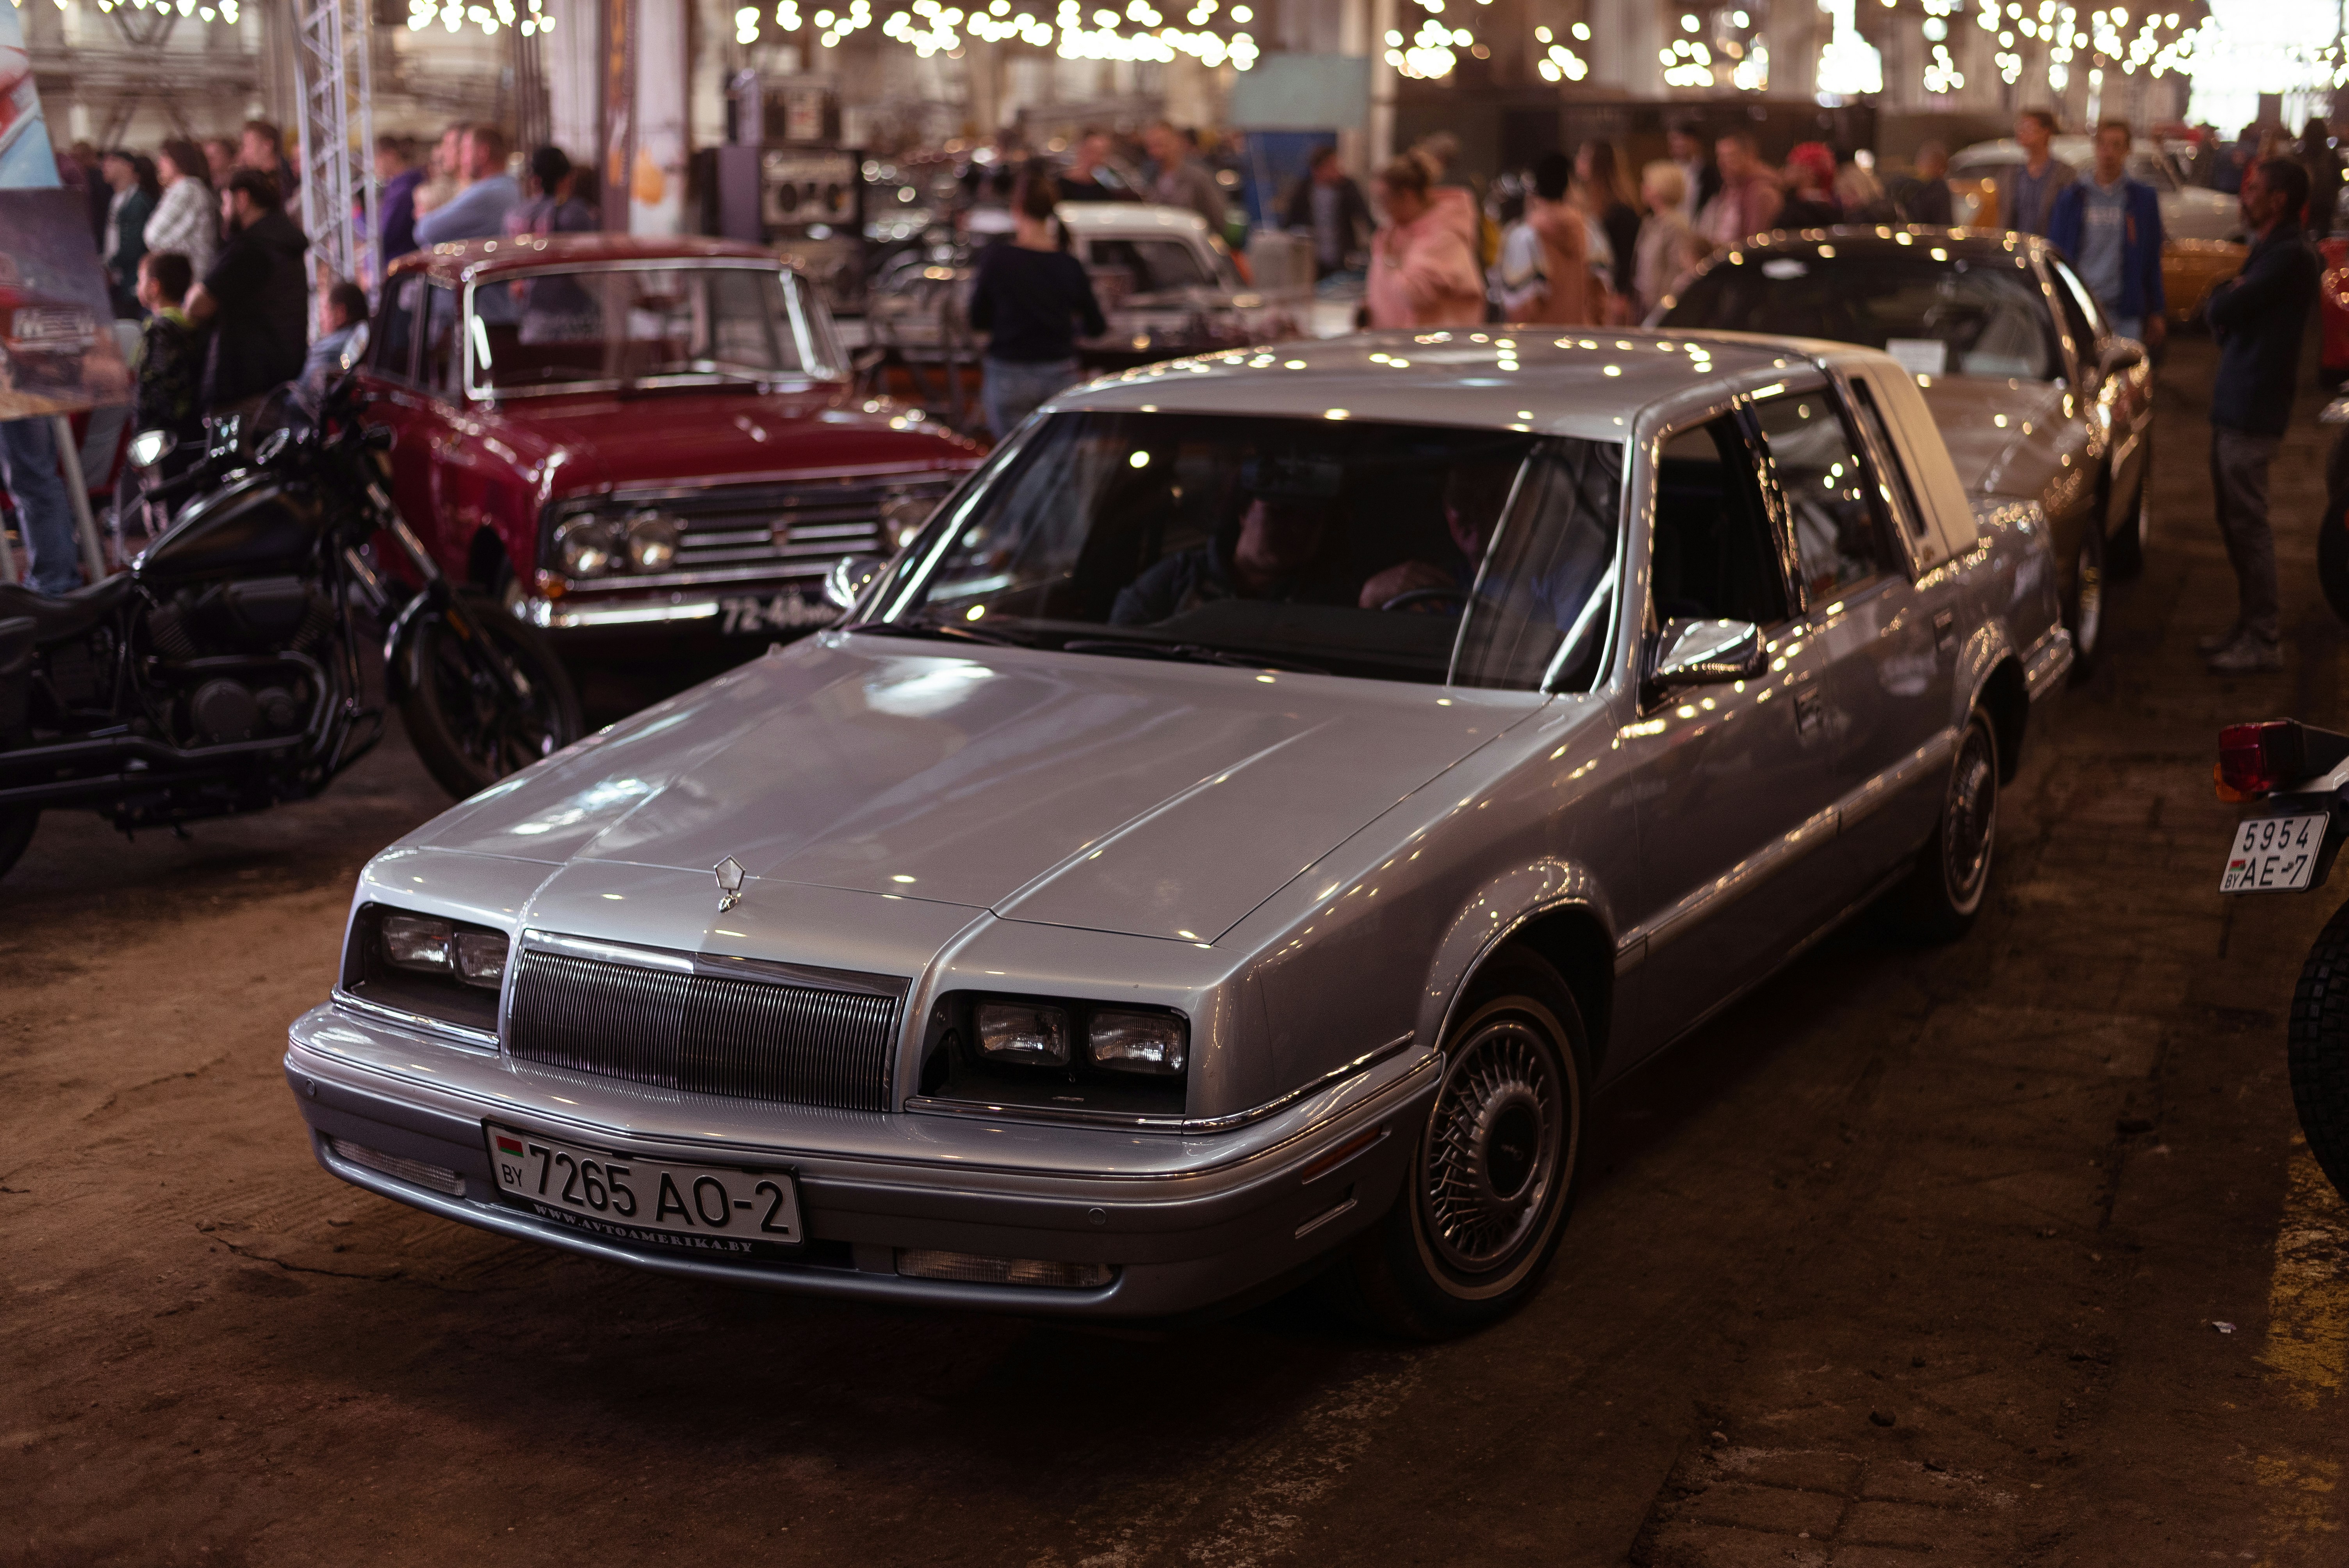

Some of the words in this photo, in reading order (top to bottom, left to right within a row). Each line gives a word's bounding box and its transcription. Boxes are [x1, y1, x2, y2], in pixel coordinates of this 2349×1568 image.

[2243, 819, 2311, 852] 5954
[2224, 874, 2240, 888] BY
[2239, 854, 2308, 886] AE-7
[501, 1163, 522, 1187] BY
[528, 1142, 637, 1217] 7265
[655, 1172, 789, 1234] AO-2
[533, 1204, 752, 1252] WWW.AVTOAMERIKA.BY
